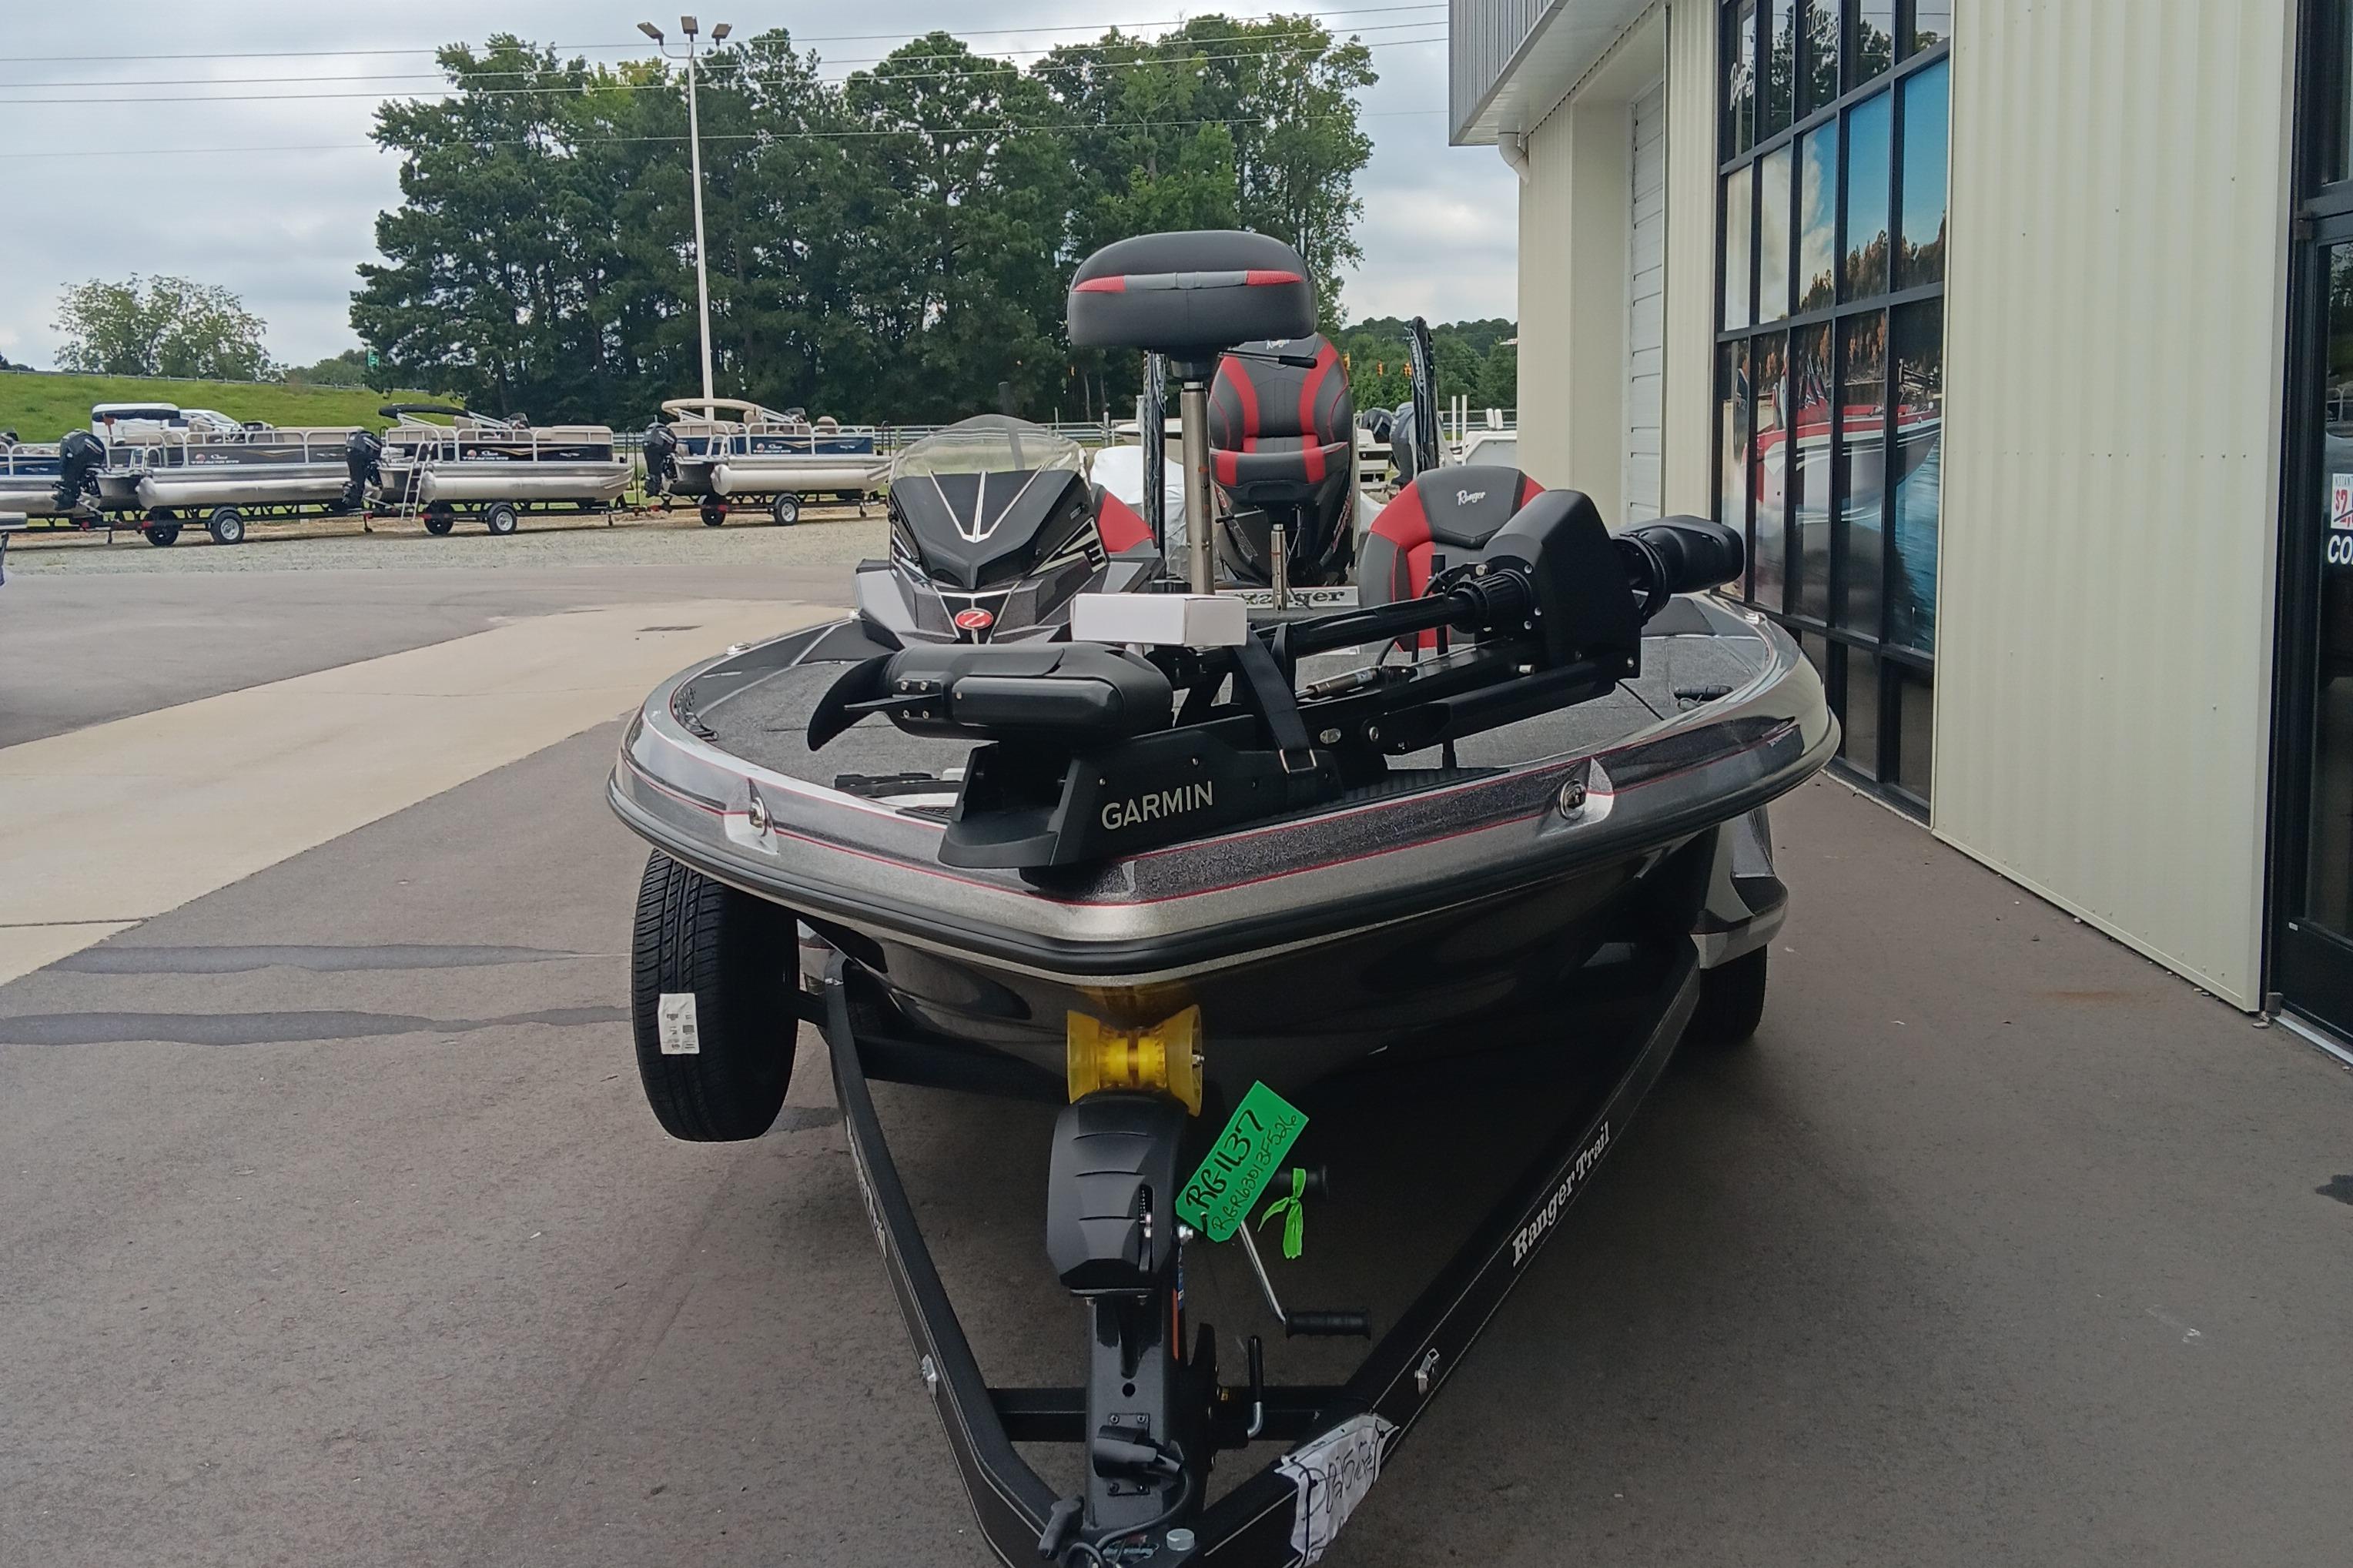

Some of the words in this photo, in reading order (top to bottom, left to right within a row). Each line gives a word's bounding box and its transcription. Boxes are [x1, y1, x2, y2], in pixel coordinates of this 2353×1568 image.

[1456, 490, 1486, 506] Ranger
[2328, 535, 2353, 564] CO
[1102, 781, 1213, 830] GARMIN
[1186, 1109, 1264, 1210] RG1137
[1512, 1171, 1575, 1268] Ranger
[1576, 1121, 1610, 1181] Trail
